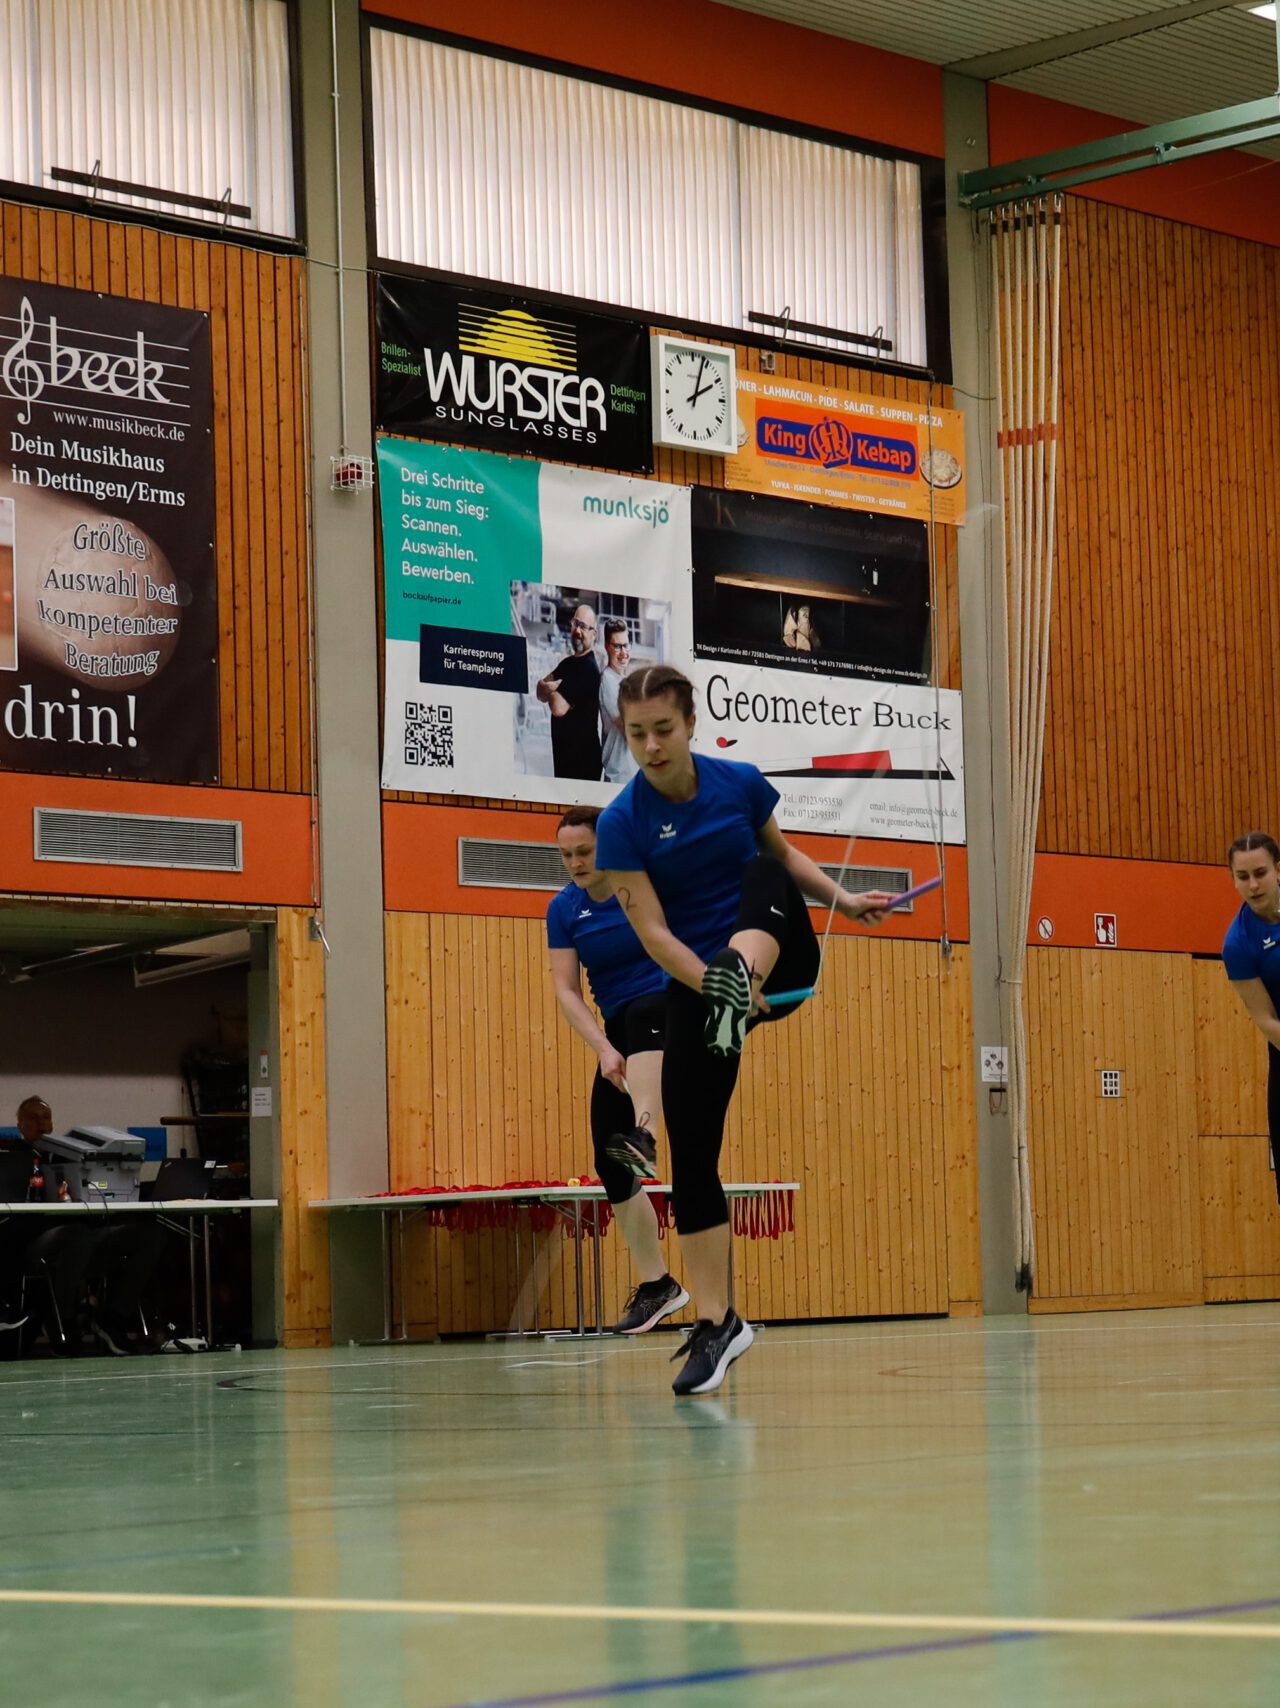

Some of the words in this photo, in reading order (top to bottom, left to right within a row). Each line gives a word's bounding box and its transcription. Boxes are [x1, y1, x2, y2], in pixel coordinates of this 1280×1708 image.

[50, 316, 171, 404] beck
[381, 341, 411, 357] Brillen-
[382, 360, 422, 376] Spezialist
[424, 347, 607, 431] WURSTER
[610, 384, 646, 402] Dettingen
[763, 385, 813, 403] LAHMACUN
[819, 396, 838, 407] PIDE
[844, 400, 874, 415] SALATE
[880, 407, 913, 422] SUPPEN
[611, 399, 638, 415] Karlstr.
[53, 410, 185, 443] www.musikbeck.de
[435, 405, 597, 444] SUNGLASSES
[764, 423, 806, 449] King
[10, 432, 57, 459] Dein
[61, 439, 165, 474] Musikhaus
[857, 438, 912, 471] Kebap
[12, 464, 32, 485] in
[37, 468, 185, 507] Dettingen/Erms
[401, 467, 428, 487] Drei
[432, 472, 485, 494] Schritte
[401, 490, 421, 507] bis
[425, 498, 451, 512] zum
[455, 500, 489, 520] Sieg:
[583, 495, 669, 528] munksjö
[73, 521, 147, 561] Größte
[401, 515, 462, 537] Scannen.
[401, 538, 478, 563] Auswählen.
[44, 567, 138, 598] Auswahl
[144, 576, 178, 605] bei
[402, 562, 475, 584] Bewerben.
[402, 591, 462, 605] bockaufpapier.de
[38, 599, 178, 638] kompetenter
[64, 642, 159, 677] Beratung
[443, 644, 505, 662] Karrieresprung
[444, 658, 455, 669] für
[457, 660, 505, 676] Teamplayer
[5, 684, 139, 748] drin!
[707, 673, 862, 727] Geometer
[872, 702, 952, 731] Buck
